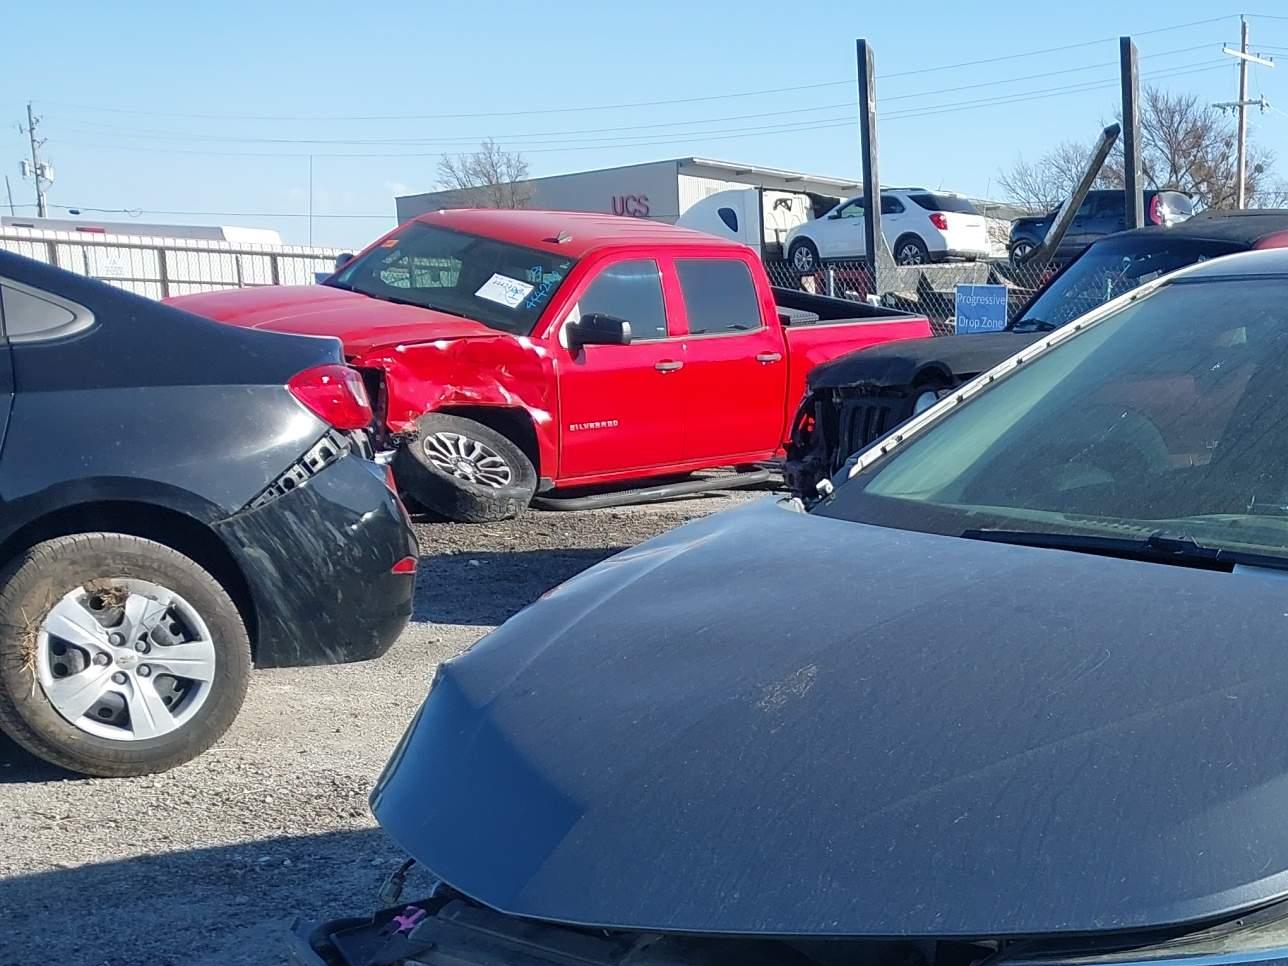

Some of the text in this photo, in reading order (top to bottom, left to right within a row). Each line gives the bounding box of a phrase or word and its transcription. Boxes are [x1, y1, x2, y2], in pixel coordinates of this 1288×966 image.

[611, 193, 649, 217] UCS
[957, 292, 1006, 306] Progressive
[958, 316, 1004, 329] Drop Zone
[569, 419, 619, 432] SILVERADO
